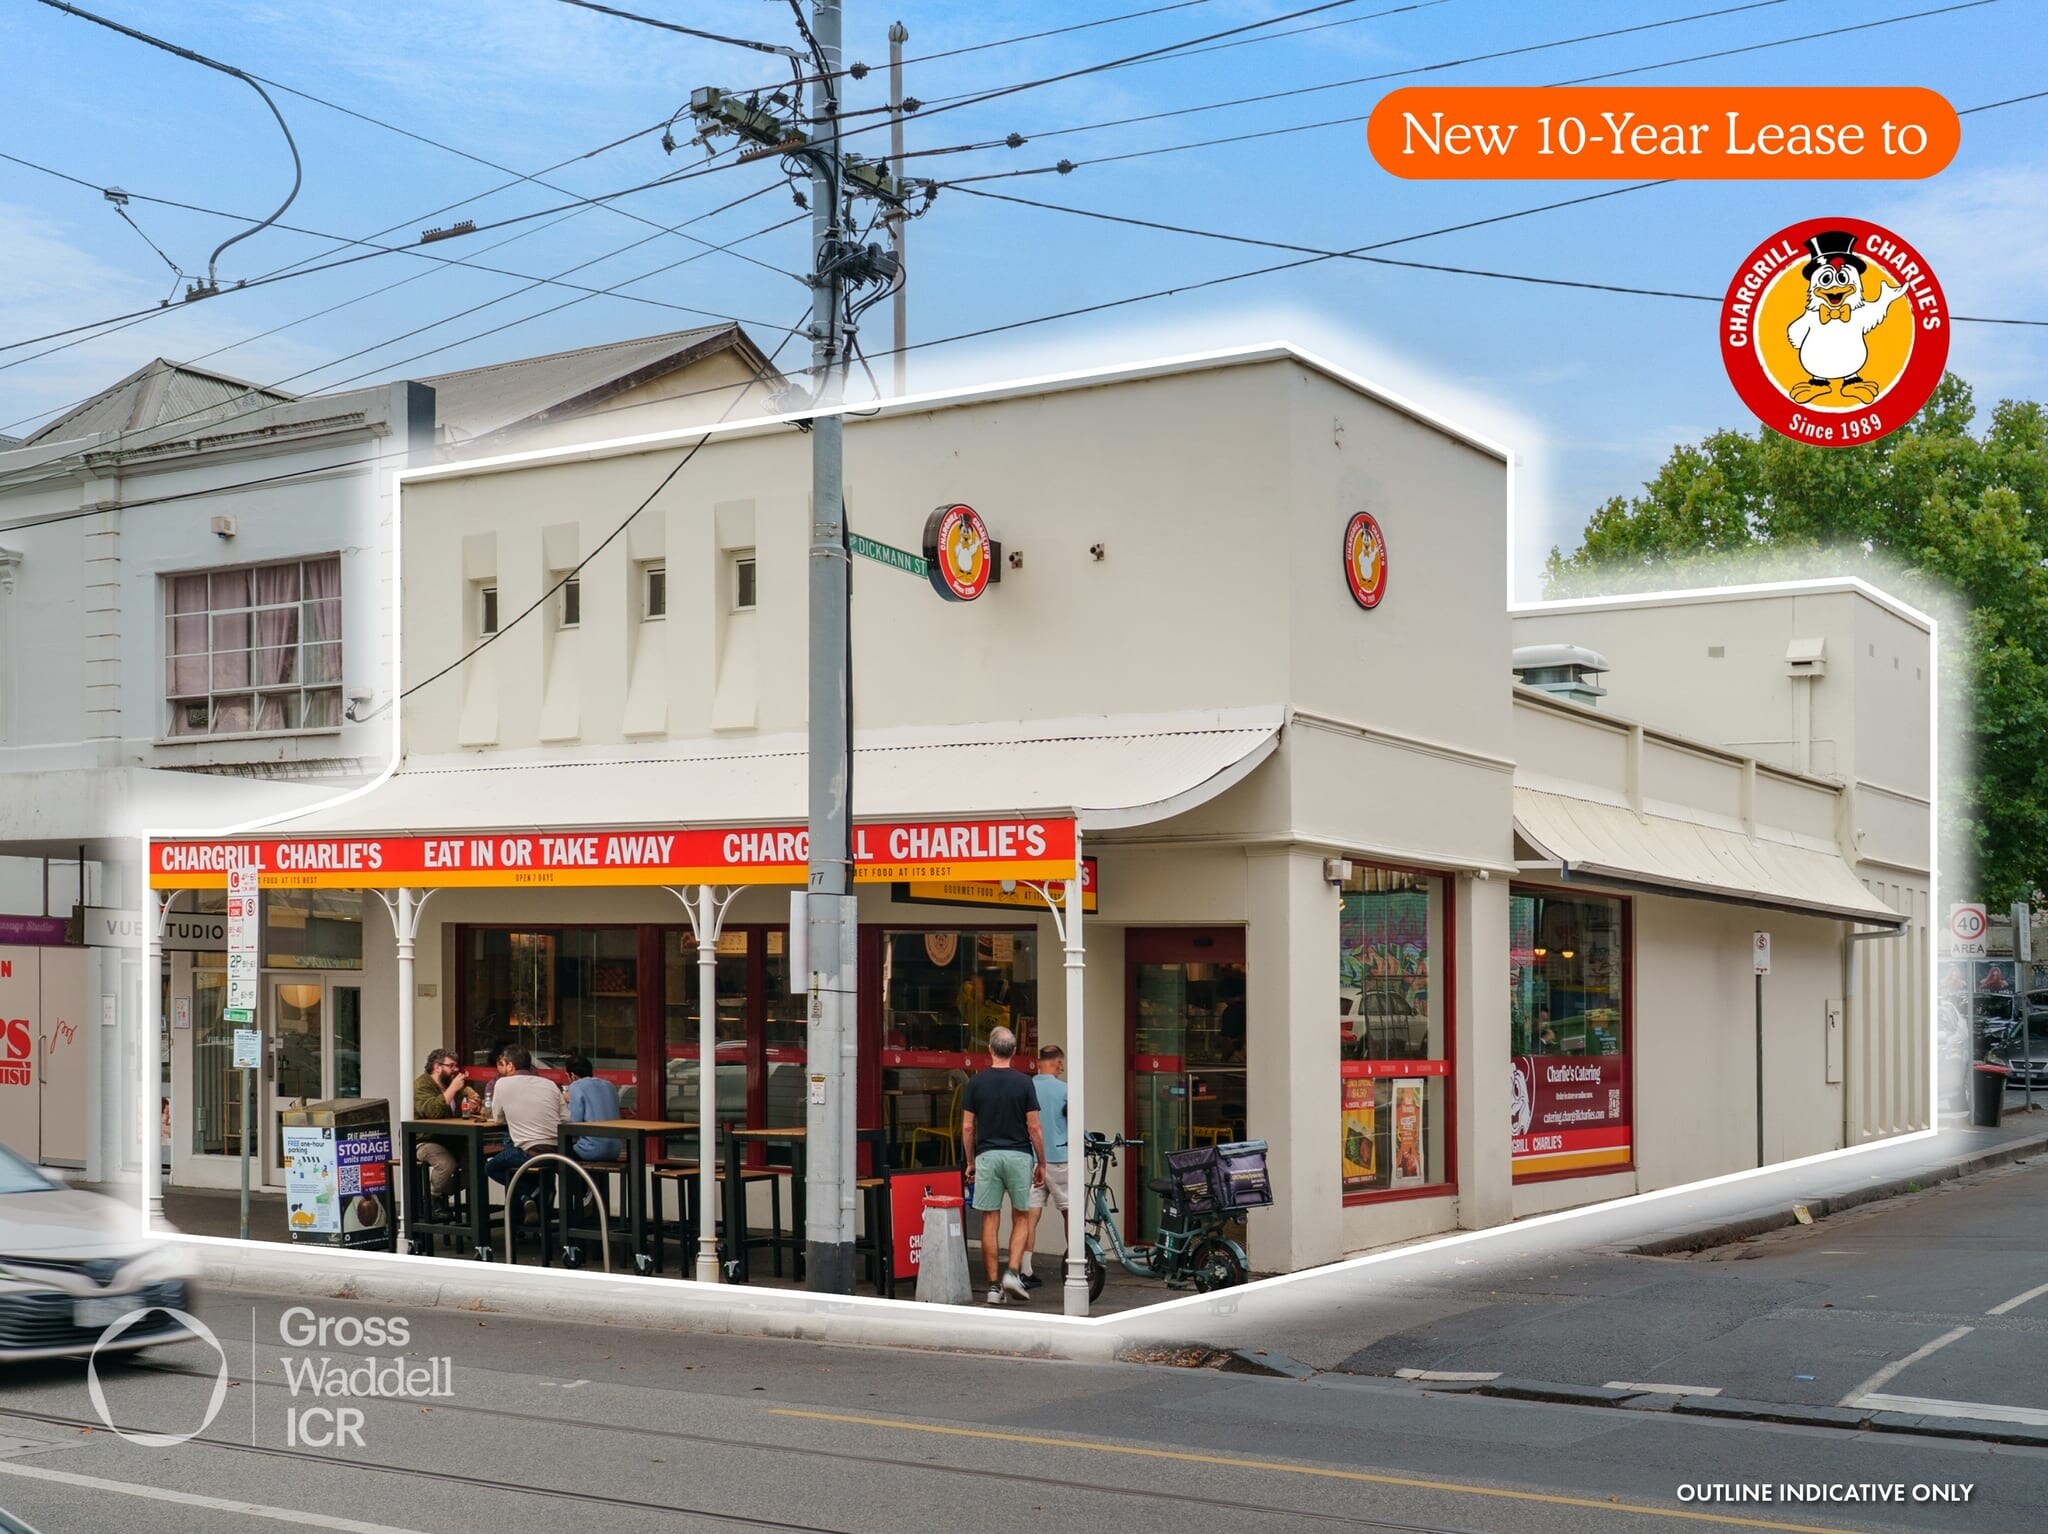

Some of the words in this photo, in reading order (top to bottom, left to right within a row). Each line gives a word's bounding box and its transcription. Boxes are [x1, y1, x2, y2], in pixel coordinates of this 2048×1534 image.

[858, 537, 912, 569] DICKMANN
[914, 561, 926, 576] ST
[161, 843, 266, 871] CHARGRILL
[276, 842, 383, 870] CHARLIE'S
[423, 840, 464, 868] EAT
[470, 839, 493, 866] IN
[500, 837, 533, 865] OR
[539, 836, 599, 865] TAKE
[604, 834, 676, 865] AWAY
[889, 824, 1047, 860] CHARLIE'S
[872, 867, 893, 877] FOOD
[898, 867, 908, 876] AT
[912, 867, 926, 876] ITS
[930, 866, 952, 876] BEST
[944, 884, 974, 896] GOURMET
[976, 887, 994, 898] FOOD
[1957, 915, 1981, 931] 40
[164, 922, 224, 940] TUDIO
[1952, 943, 1985, 954] AREA
[230, 954, 242, 969] 2P
[1546, 1064, 1574, 1083] Charlie's
[1575, 1064, 1601, 1085] Catering
[300, 1140, 325, 1148] one-hour
[338, 1140, 390, 1156] STORAGE
[1532, 1135, 1563, 1151] CHARLIE'S
[287, 1147, 308, 1155] parking
[343, 1155, 359, 1164] units
[374, 1154, 386, 1162] you
